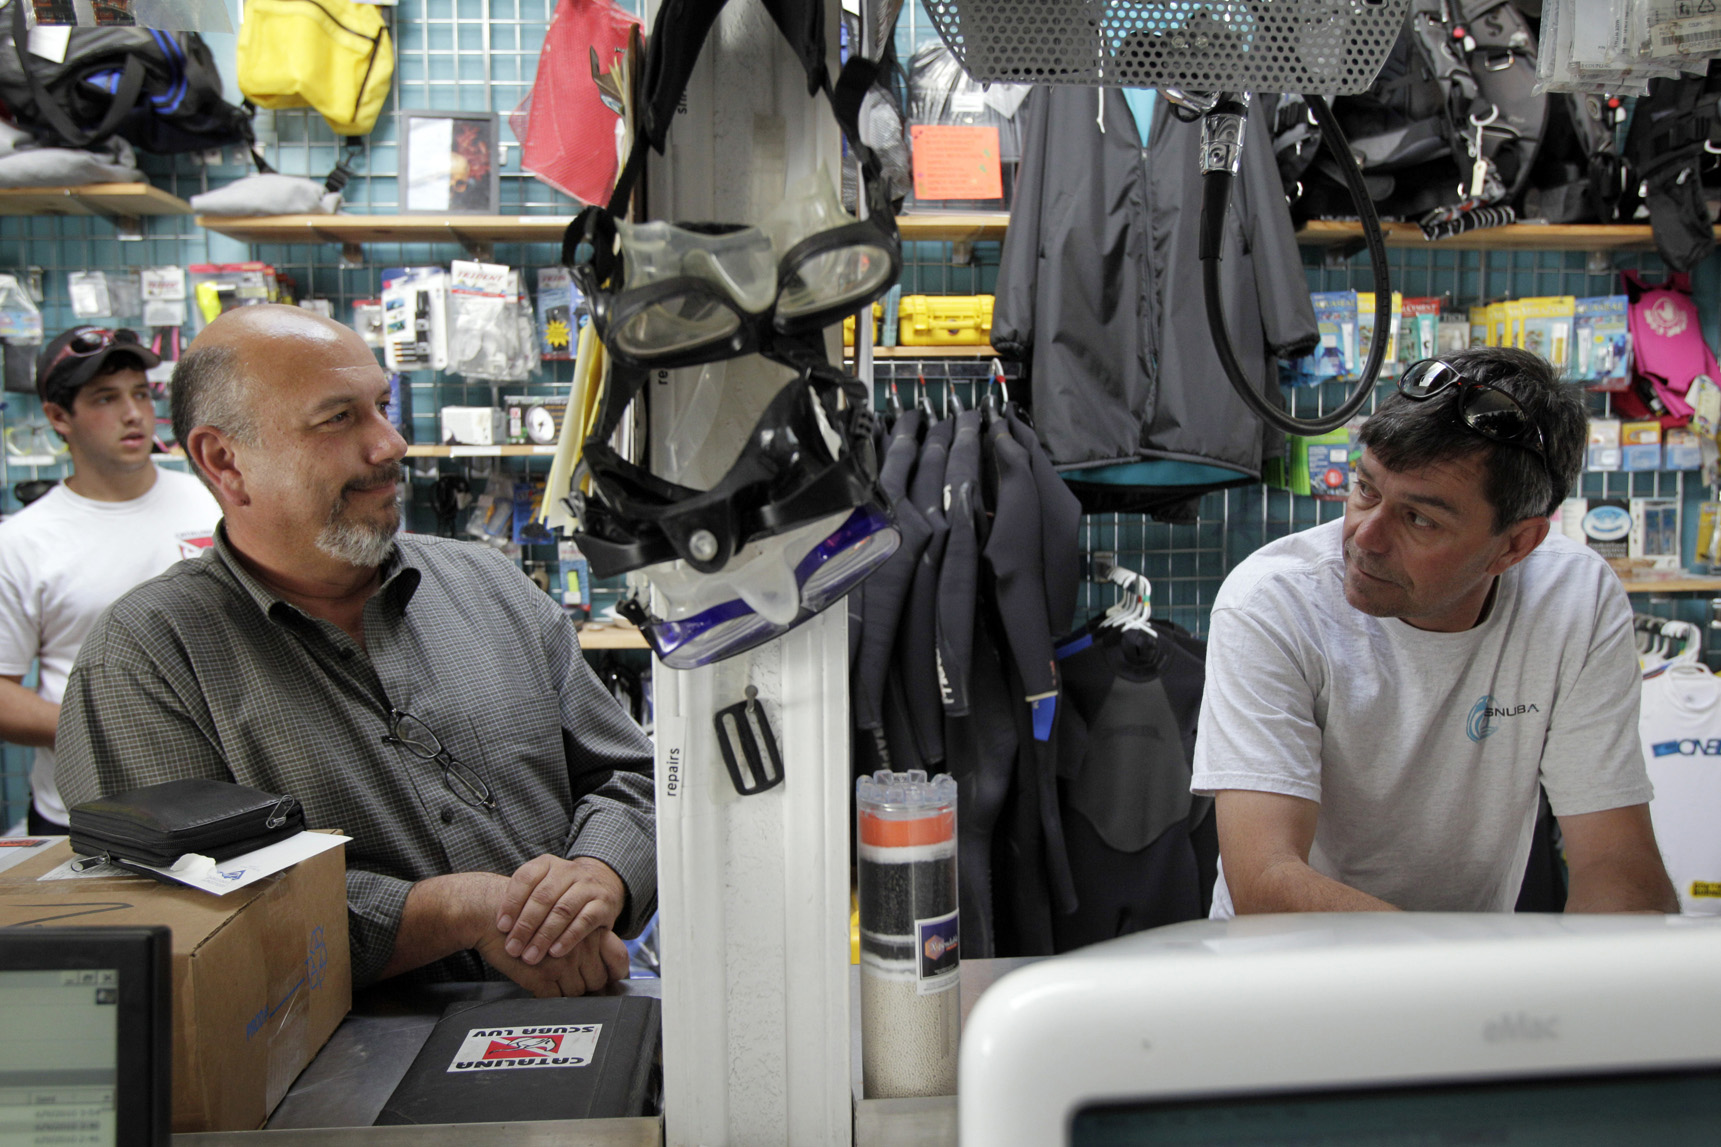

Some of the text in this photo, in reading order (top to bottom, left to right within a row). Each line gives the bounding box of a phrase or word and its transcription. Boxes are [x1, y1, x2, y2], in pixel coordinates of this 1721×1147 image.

[1483, 703, 1540, 717] SNUBA
[666, 747, 680, 797] repairs
[472, 1026, 595, 1037] SCUBA LUV
[455, 1057, 585, 1069] CATALINA
